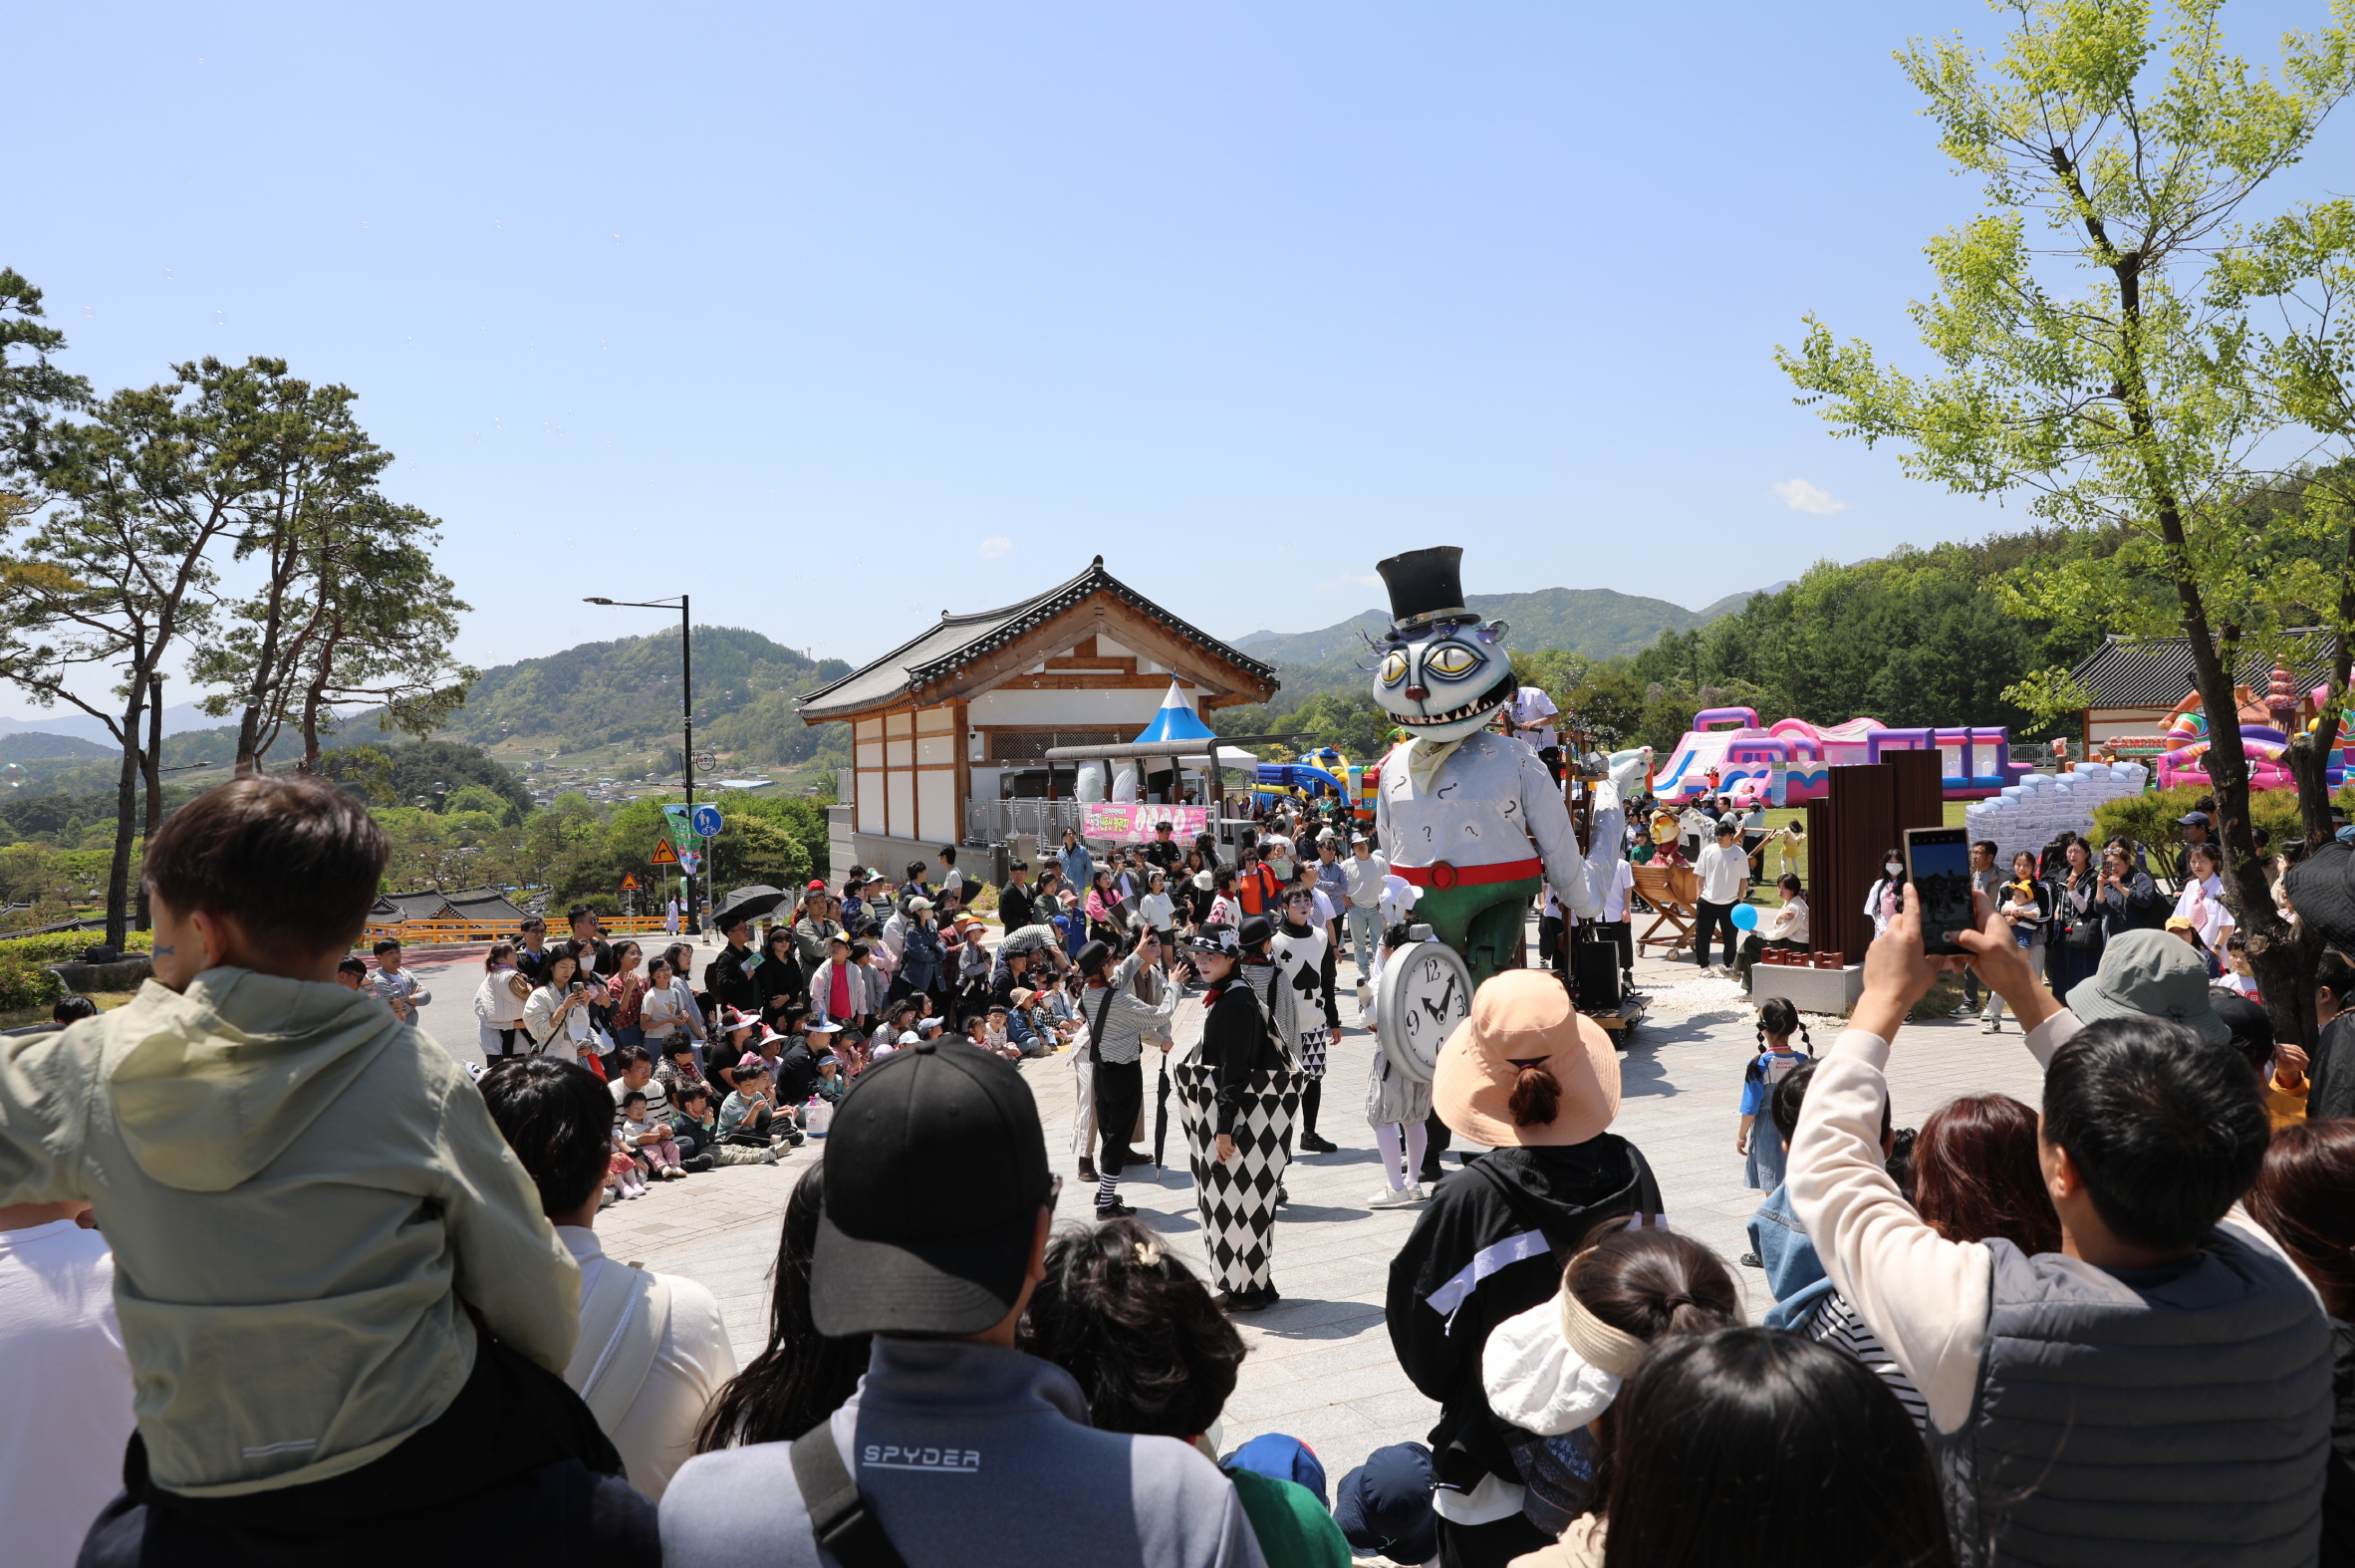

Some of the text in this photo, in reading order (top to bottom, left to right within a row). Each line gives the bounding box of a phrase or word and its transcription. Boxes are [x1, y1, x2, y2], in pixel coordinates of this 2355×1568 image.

[1424, 959, 1440, 984] 12
[1454, 994, 1465, 1019] 3
[1406, 1009, 1421, 1037] 9
[864, 1444, 980, 1466] SPYDER
